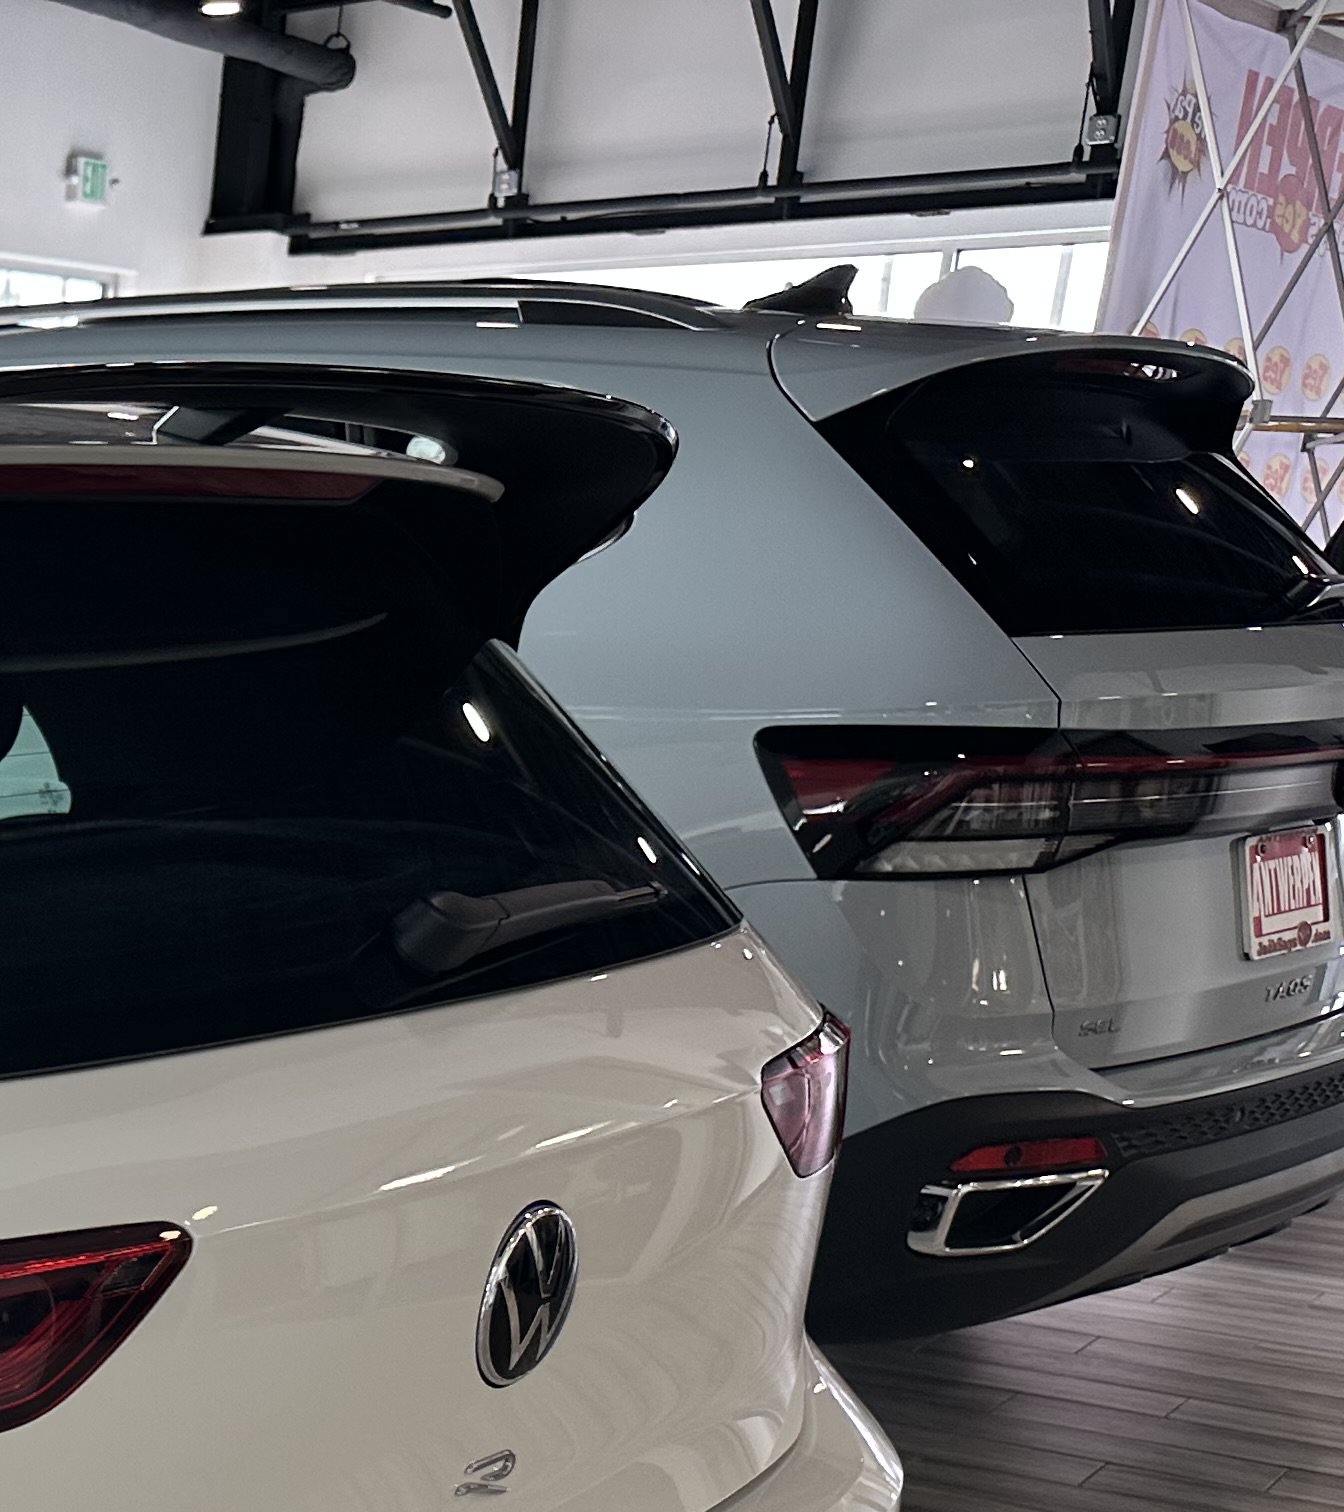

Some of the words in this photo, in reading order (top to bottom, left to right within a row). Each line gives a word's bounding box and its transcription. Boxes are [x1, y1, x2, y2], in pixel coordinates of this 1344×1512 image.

[1249, 852, 1322, 917] ANTWERPEN
[1264, 974, 1313, 1002] TAOS
[1078, 1018, 1121, 1038] SEL
